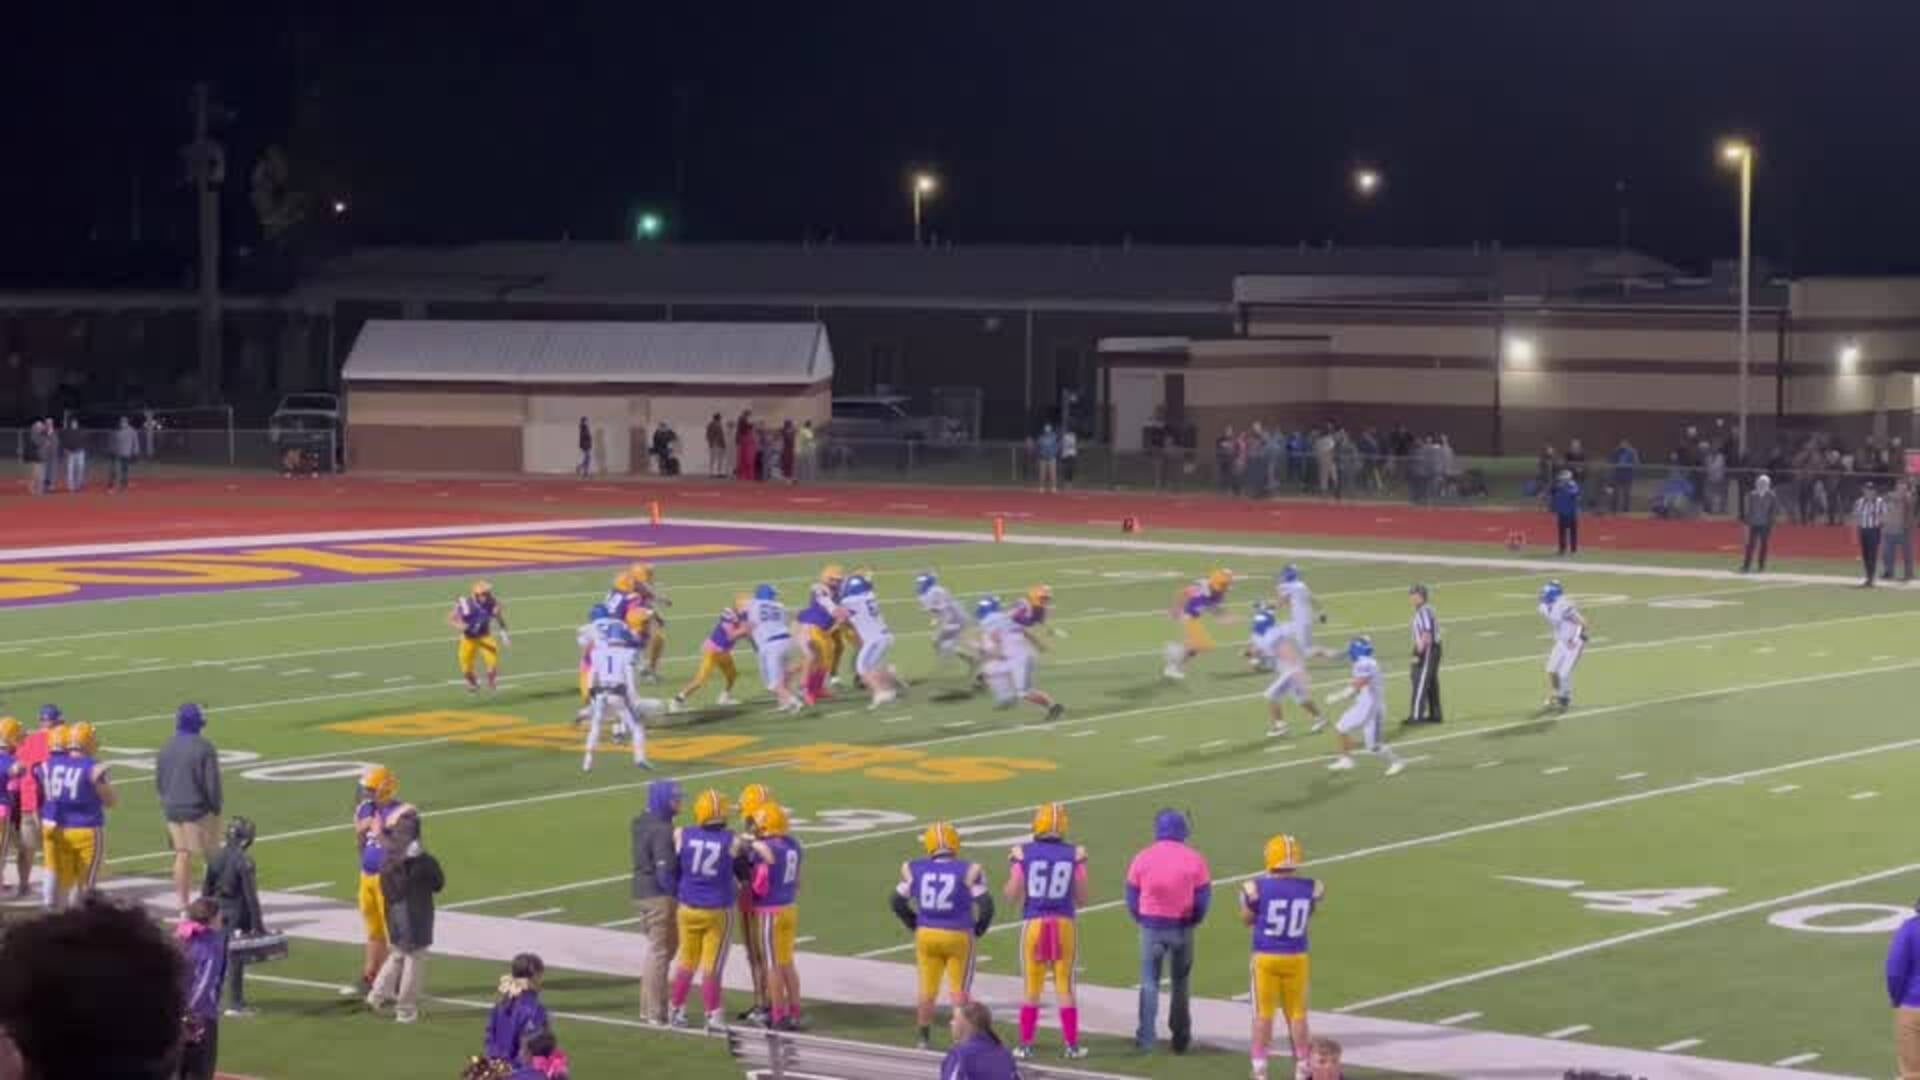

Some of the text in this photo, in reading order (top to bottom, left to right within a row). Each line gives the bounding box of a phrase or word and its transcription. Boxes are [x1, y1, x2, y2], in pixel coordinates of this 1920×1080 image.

[51, 765, 82, 800] 64
[689, 839, 721, 876] 72
[920, 873, 956, 911] 62
[1029, 861, 1073, 899] 68
[1263, 897, 1310, 938] 50
